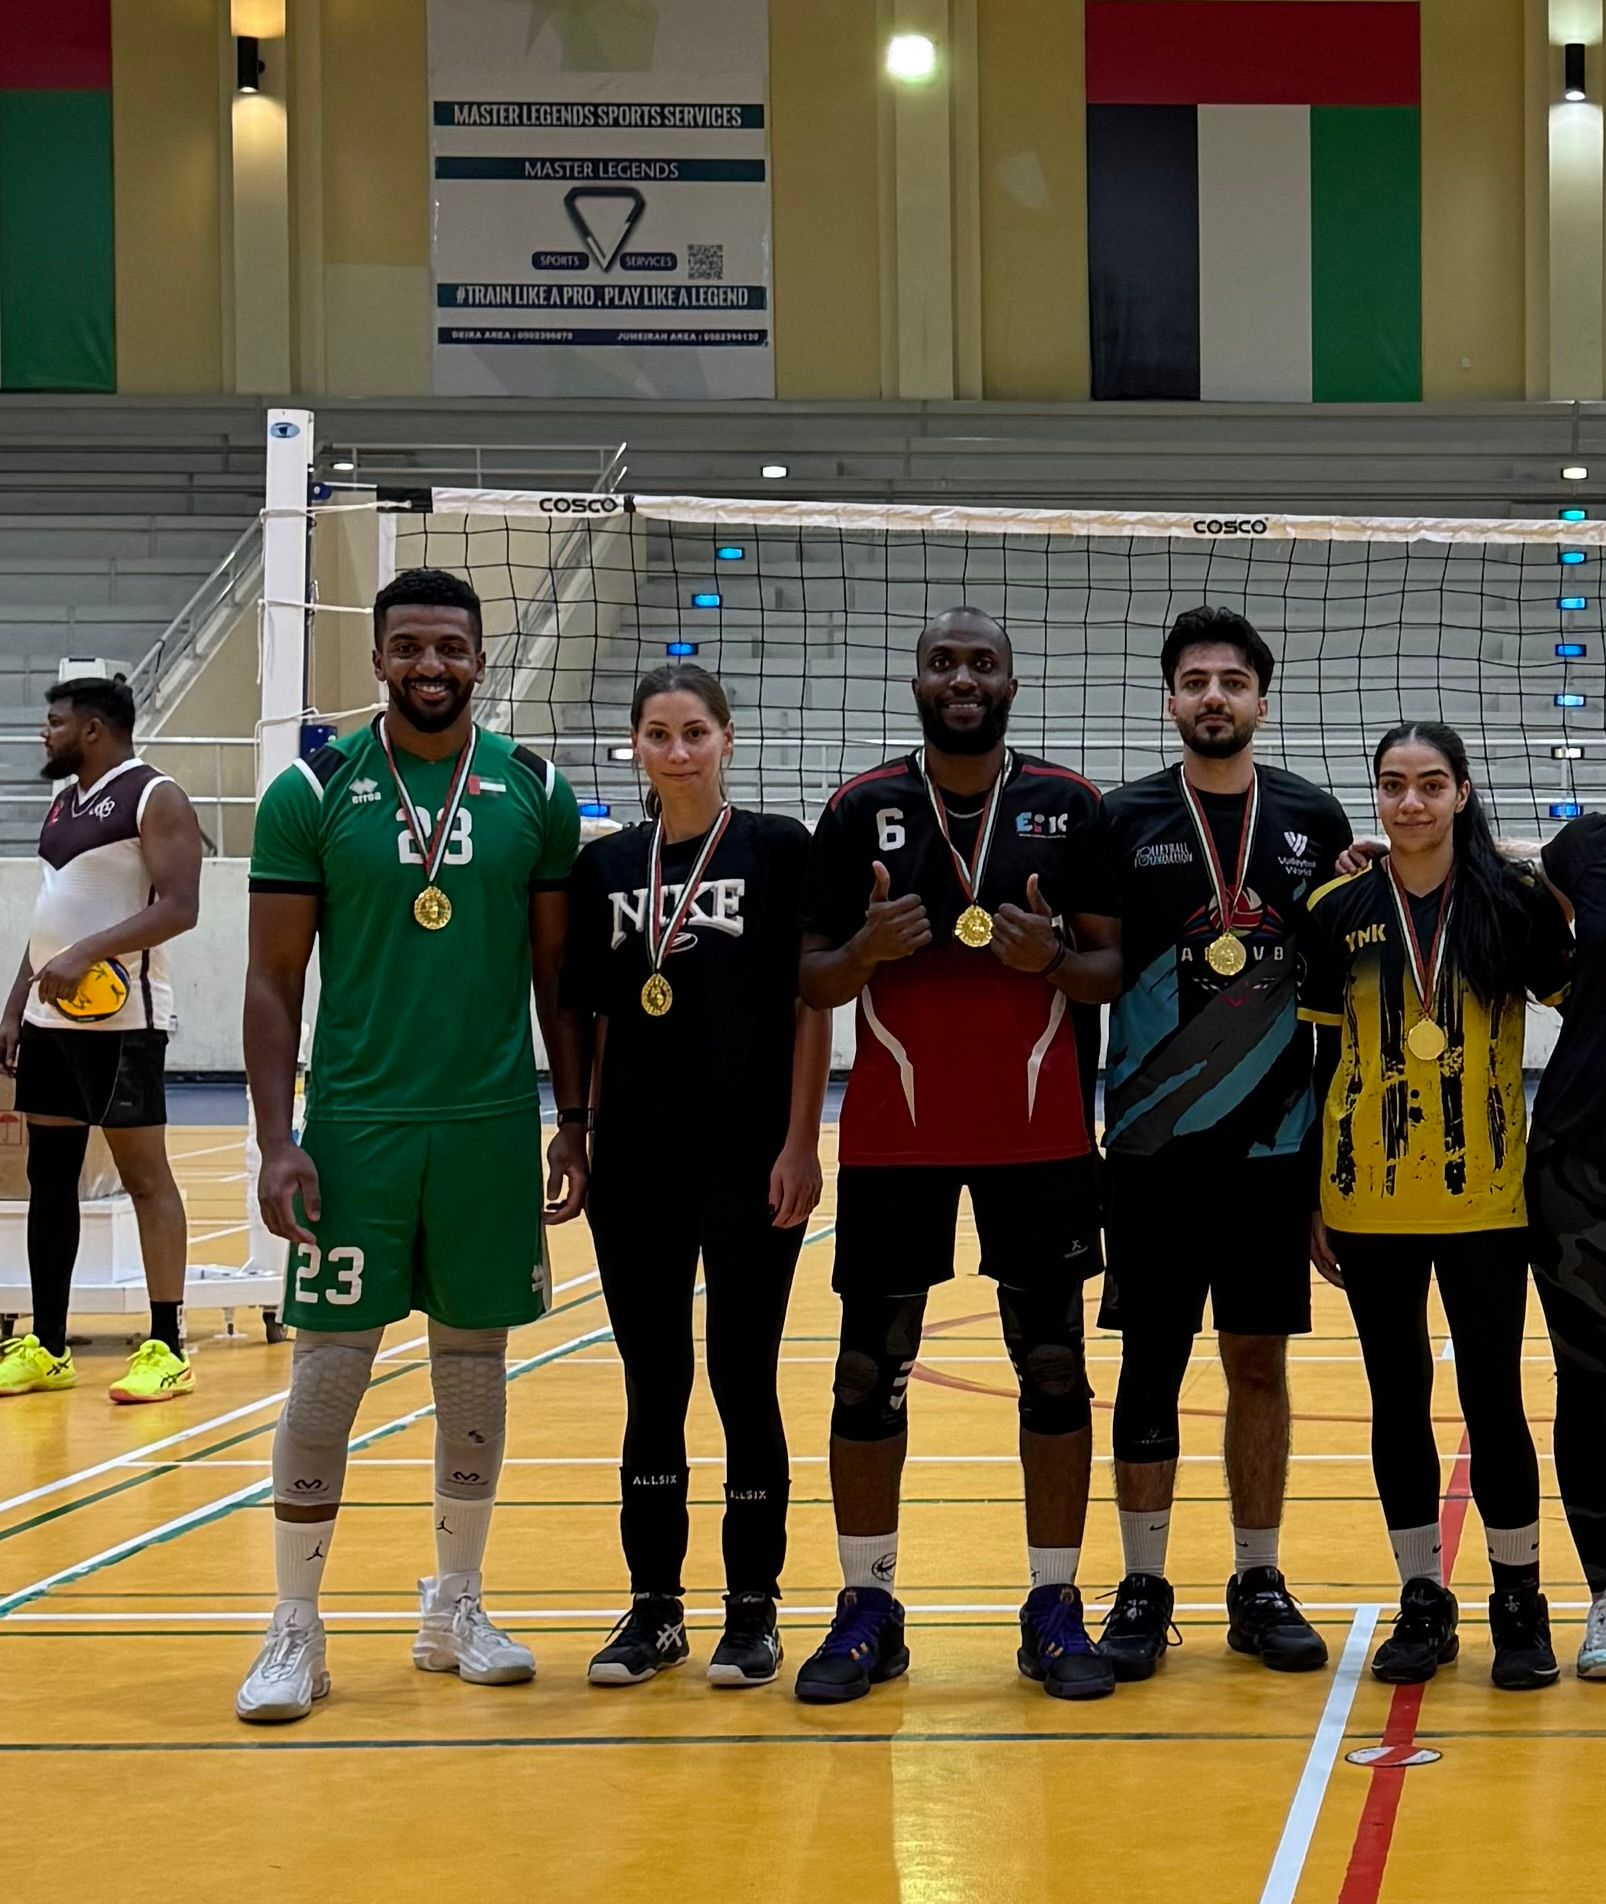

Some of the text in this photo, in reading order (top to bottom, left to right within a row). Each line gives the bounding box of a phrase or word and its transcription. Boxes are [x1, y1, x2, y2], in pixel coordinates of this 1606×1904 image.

[454, 104, 742, 127] MASTER LEGENDS SPORTS SERVICES
[525, 161, 679, 179] MASTER LEGENDS
[540, 255, 672, 267] SPORTS SERVICES
[456, 286, 512, 305] #TRAIN
[515, 287, 548, 305] LIKE
[551, 287, 560, 305] A
[563, 287, 595, 306] PRO
[604, 287, 641, 306] PLAY
[644, 288, 676, 306] LIKE
[678, 288, 688, 306] A
[691, 288, 748, 306] LEGEND
[484, 331, 510, 339] AREA
[670, 332, 696, 341] AREA
[539, 498, 617, 513] COSCO
[1193, 519, 1267, 534] COSCO
[395, 806, 473, 865] 23
[876, 807, 906, 851] 6
[608, 879, 745, 949] NIKE
[295, 1242, 364, 1305] 23
[632, 1474, 677, 1485] ALLSIX
